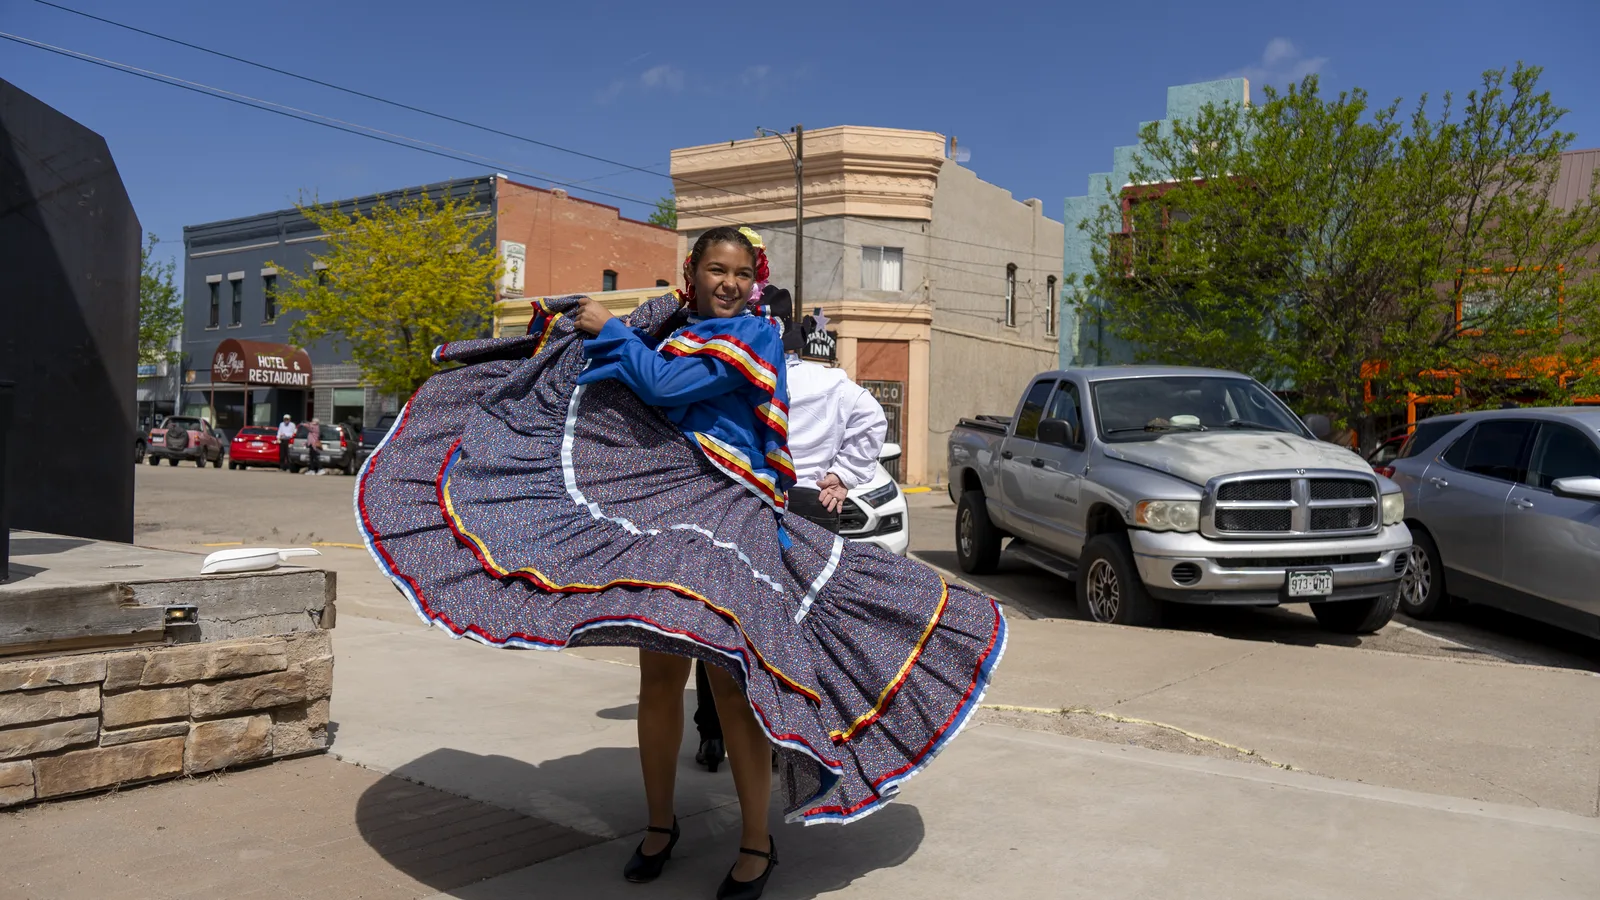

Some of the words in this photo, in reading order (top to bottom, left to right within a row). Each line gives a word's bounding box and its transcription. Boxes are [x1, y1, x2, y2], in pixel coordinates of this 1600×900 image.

[810, 343, 830, 356] INN
[257, 355, 288, 370] HOTEL
[293, 361, 301, 371] &
[249, 368, 310, 386] RESTAURANT
